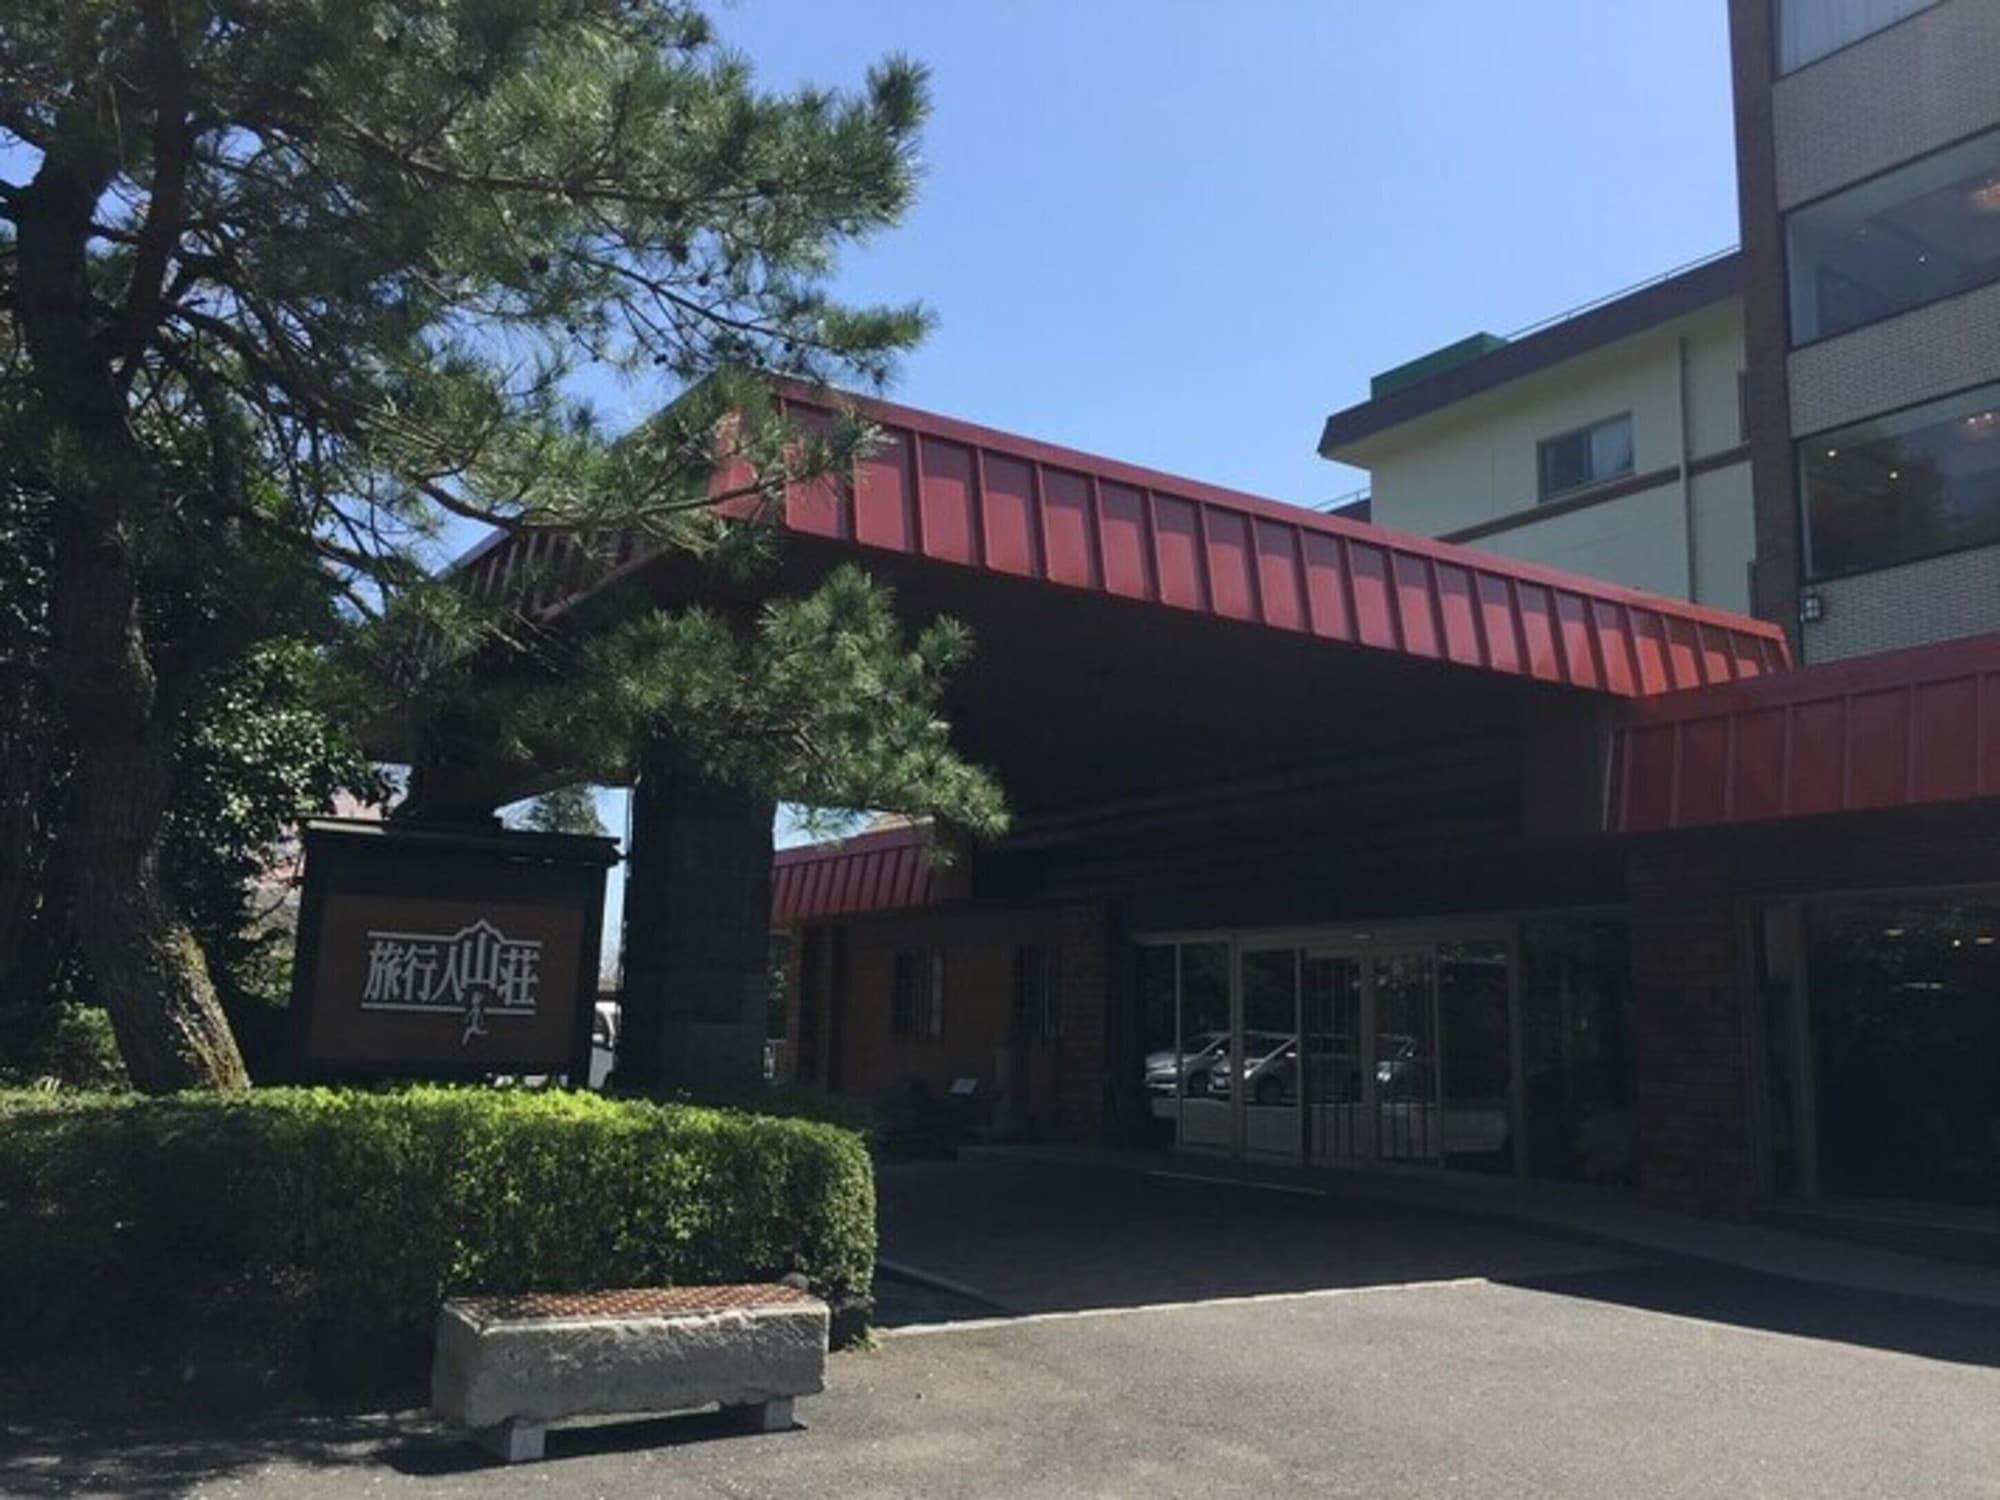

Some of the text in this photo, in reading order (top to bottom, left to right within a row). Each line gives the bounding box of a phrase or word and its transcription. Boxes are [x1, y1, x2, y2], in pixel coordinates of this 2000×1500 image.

[363, 932, 539, 1005] 旅行人山荘
